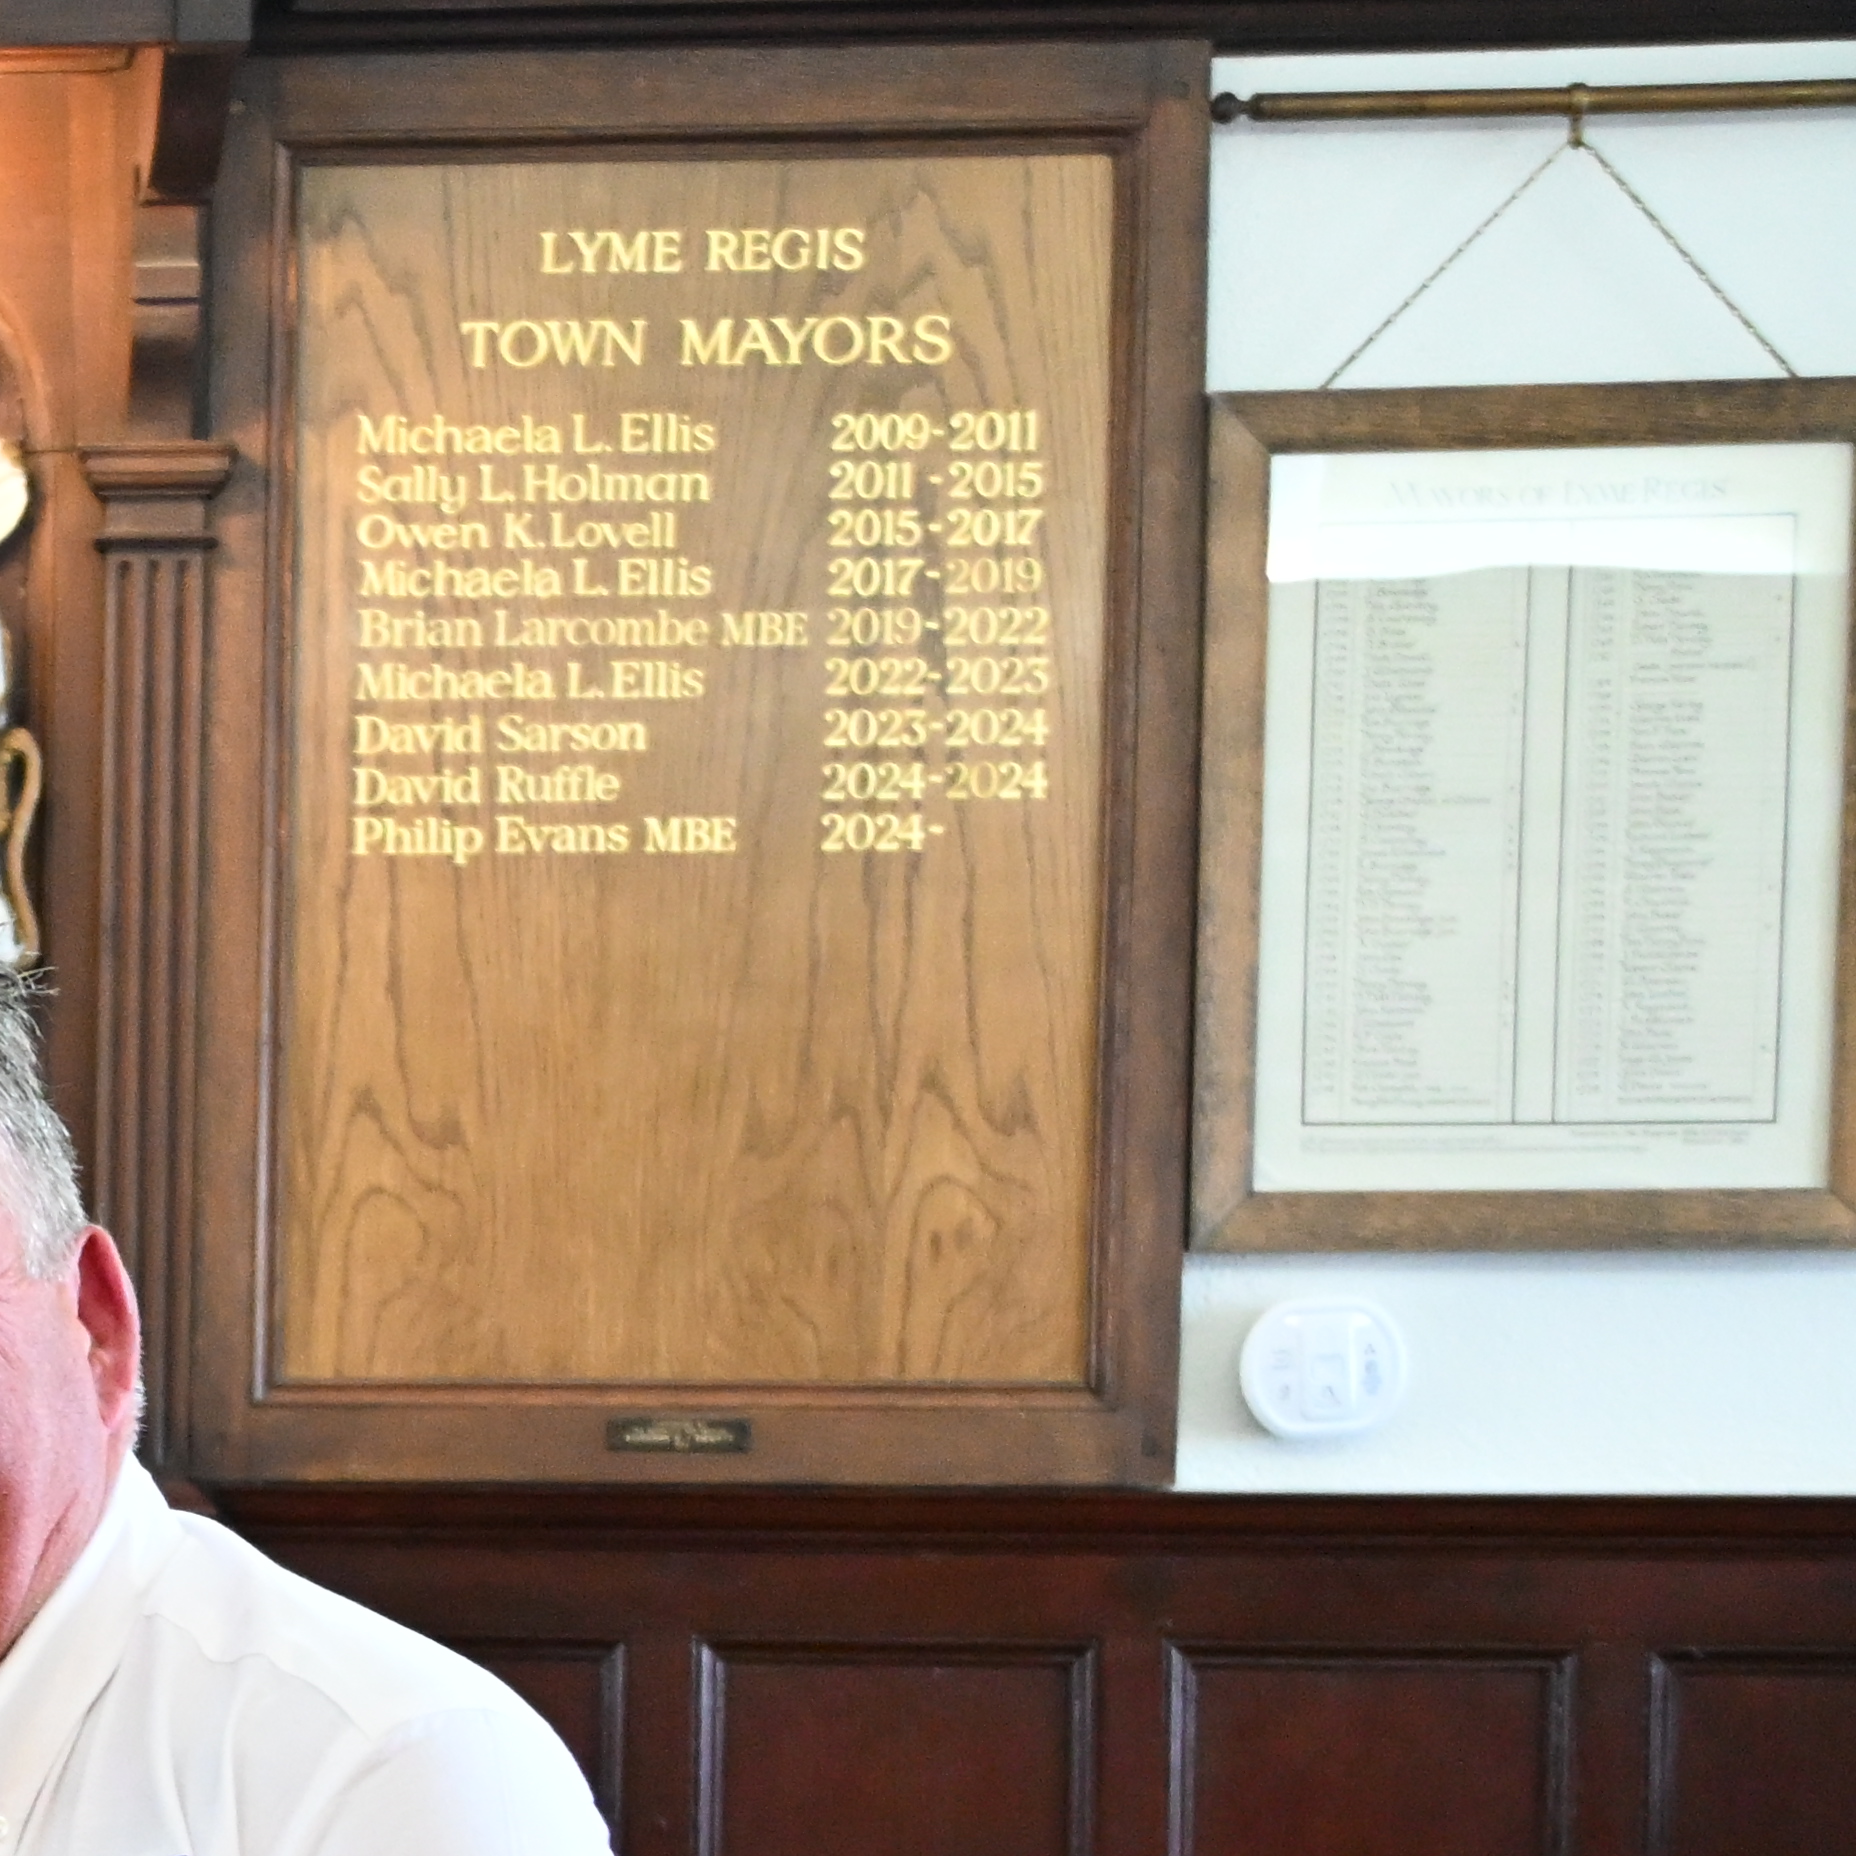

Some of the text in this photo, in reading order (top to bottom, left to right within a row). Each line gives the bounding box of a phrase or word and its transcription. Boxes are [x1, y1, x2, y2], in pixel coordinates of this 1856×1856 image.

[541, 229, 865, 274] LYME REGIS
[460, 315, 955, 368] TOWN MAYORS
[357, 413, 561, 455] Michaela
[621, 413, 715, 453] Ellis
[358, 463, 466, 513] Sally
[524, 463, 709, 503] Holman
[357, 513, 490, 550] Owen
[551, 512, 675, 549] Lovell
[359, 558, 560, 598] Michaela
[616, 558, 711, 597] Ellis
[358, 608, 808, 649] Brian Larcombe MBE
[356, 664, 555, 701] Michaela
[610, 660, 704, 698] Ellis
[354, 715, 647, 756] David Sarson
[353, 763, 621, 807] David Ruffle
[352, 815, 737, 863] Philip Evans MBE
